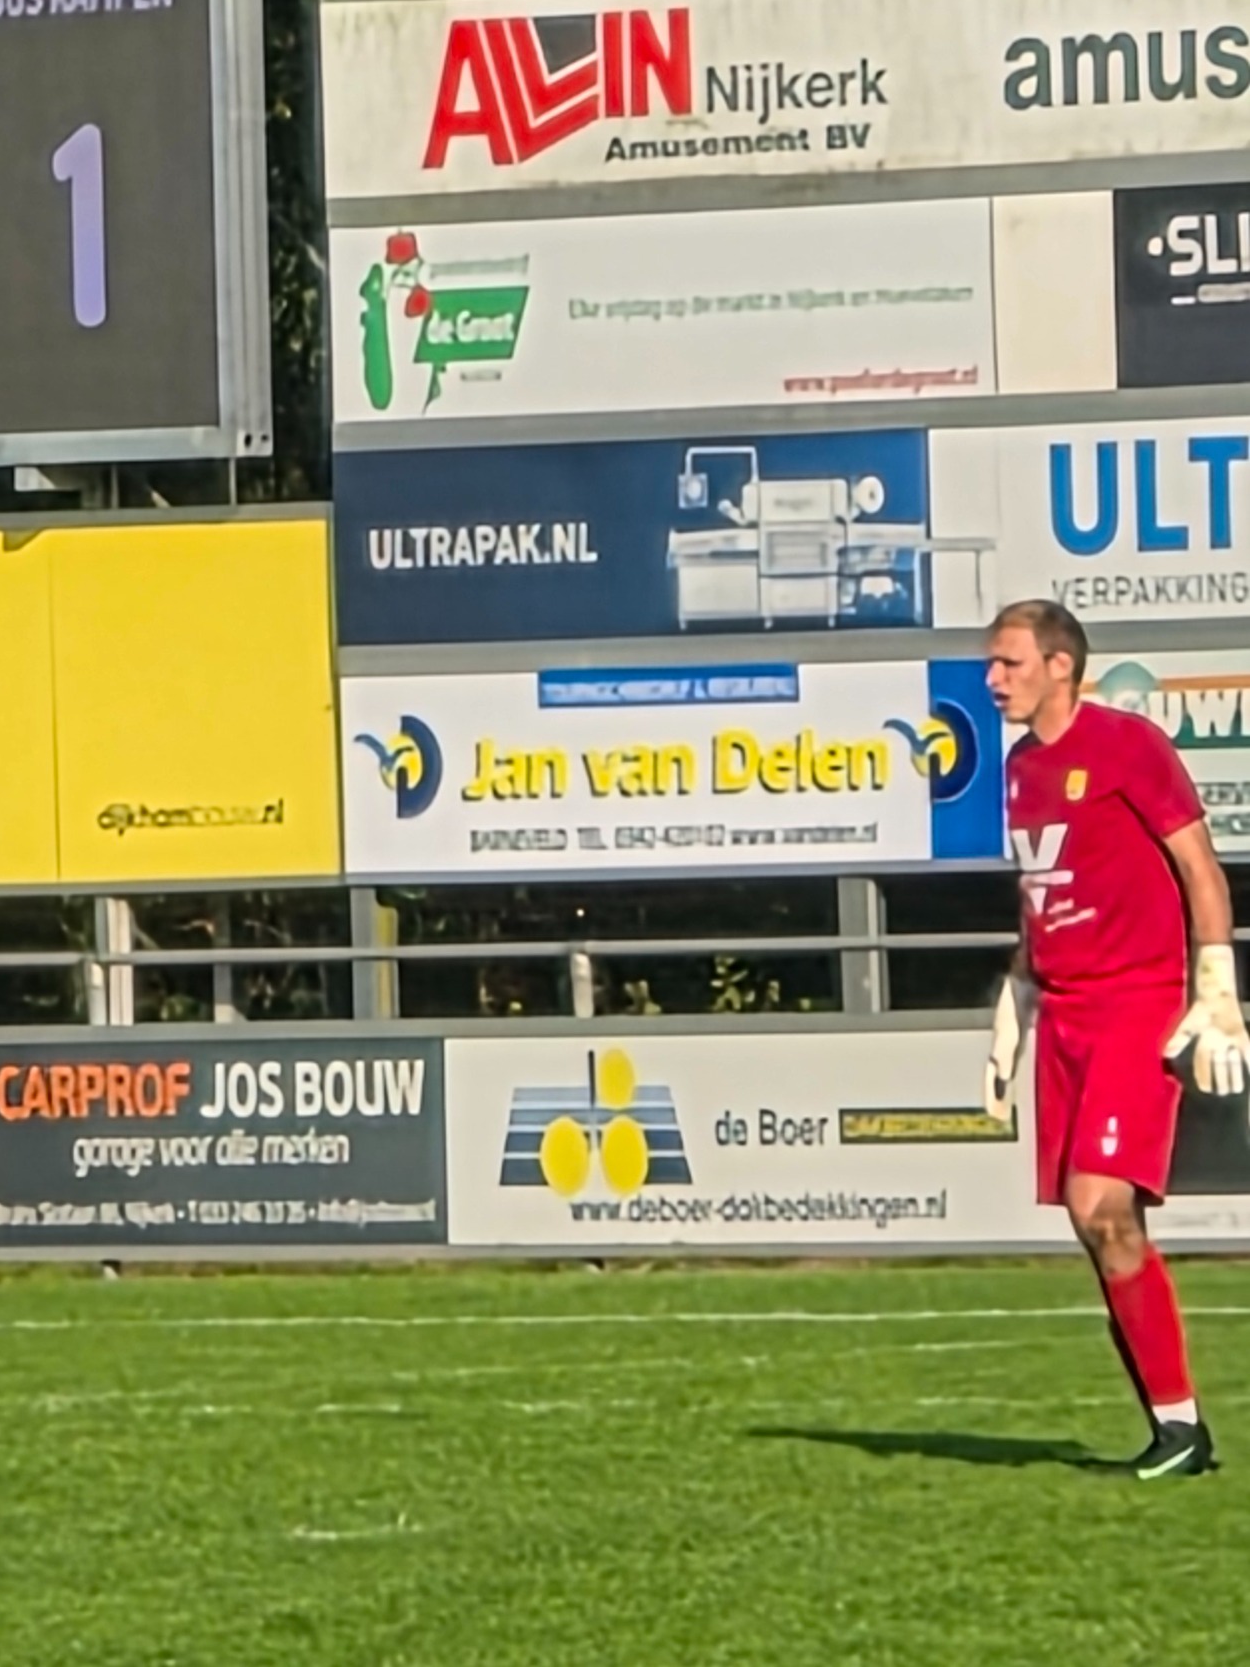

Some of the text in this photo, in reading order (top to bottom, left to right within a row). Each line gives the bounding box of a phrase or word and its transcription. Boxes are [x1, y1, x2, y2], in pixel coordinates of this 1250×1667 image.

[707, 58, 888, 124] Nijkerk
[1004, 26, 1250, 110] amus
[605, 123, 871, 163] Amusement BV
[51, 123, 107, 328] 1
[1050, 435, 1250, 556] ULT
[368, 522, 599, 571] ULTRAPAK.NL
[1051, 570, 1249, 610] VERPAKKING
[461, 727, 890, 802] Jan van Delen
[200, 1062, 284, 1117] JOS
[295, 1059, 425, 1116] BOUW
[715, 1111, 747, 1145] de
[760, 1109, 828, 1145] Boer
[73, 1138, 154, 1177] garage
[159, 1136, 213, 1166] voor
